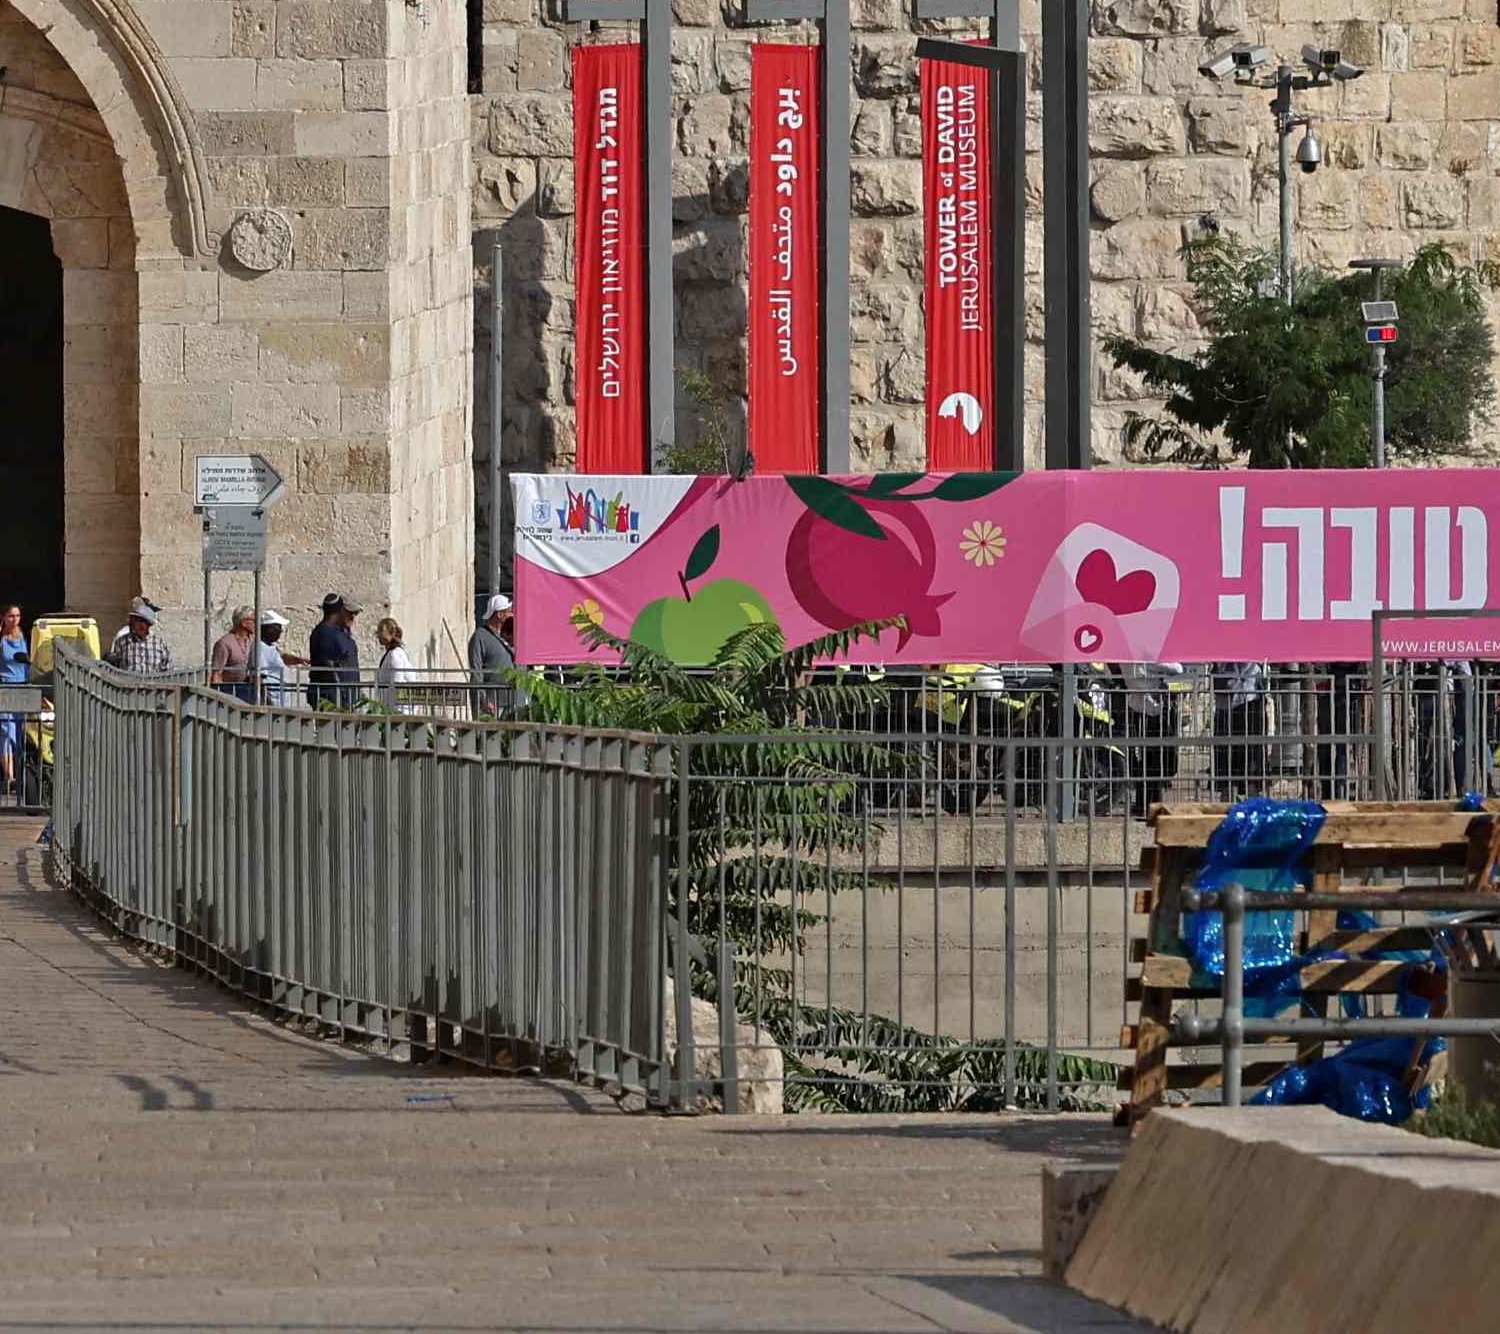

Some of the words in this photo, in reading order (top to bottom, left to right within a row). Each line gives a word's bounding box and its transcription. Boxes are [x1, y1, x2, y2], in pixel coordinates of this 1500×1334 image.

[595, 87, 618, 150] מגדל
[778, 87, 803, 130] برج
[937, 86, 956, 164] DAVID
[957, 85, 977, 191] MUSEUM
[601, 158, 618, 203] דוד
[769, 138, 798, 197] داود
[940, 172, 954, 188] of
[601, 208, 623, 295] מוזיאון
[771, 206, 793, 281] متحف
[938, 194, 958, 288] TOWER
[960, 200, 983, 331] JERUSALEM
[597, 303, 621, 399] ירושלים
[768, 289, 798, 376] القدس
[1217, 486, 1489, 621] טובה!
